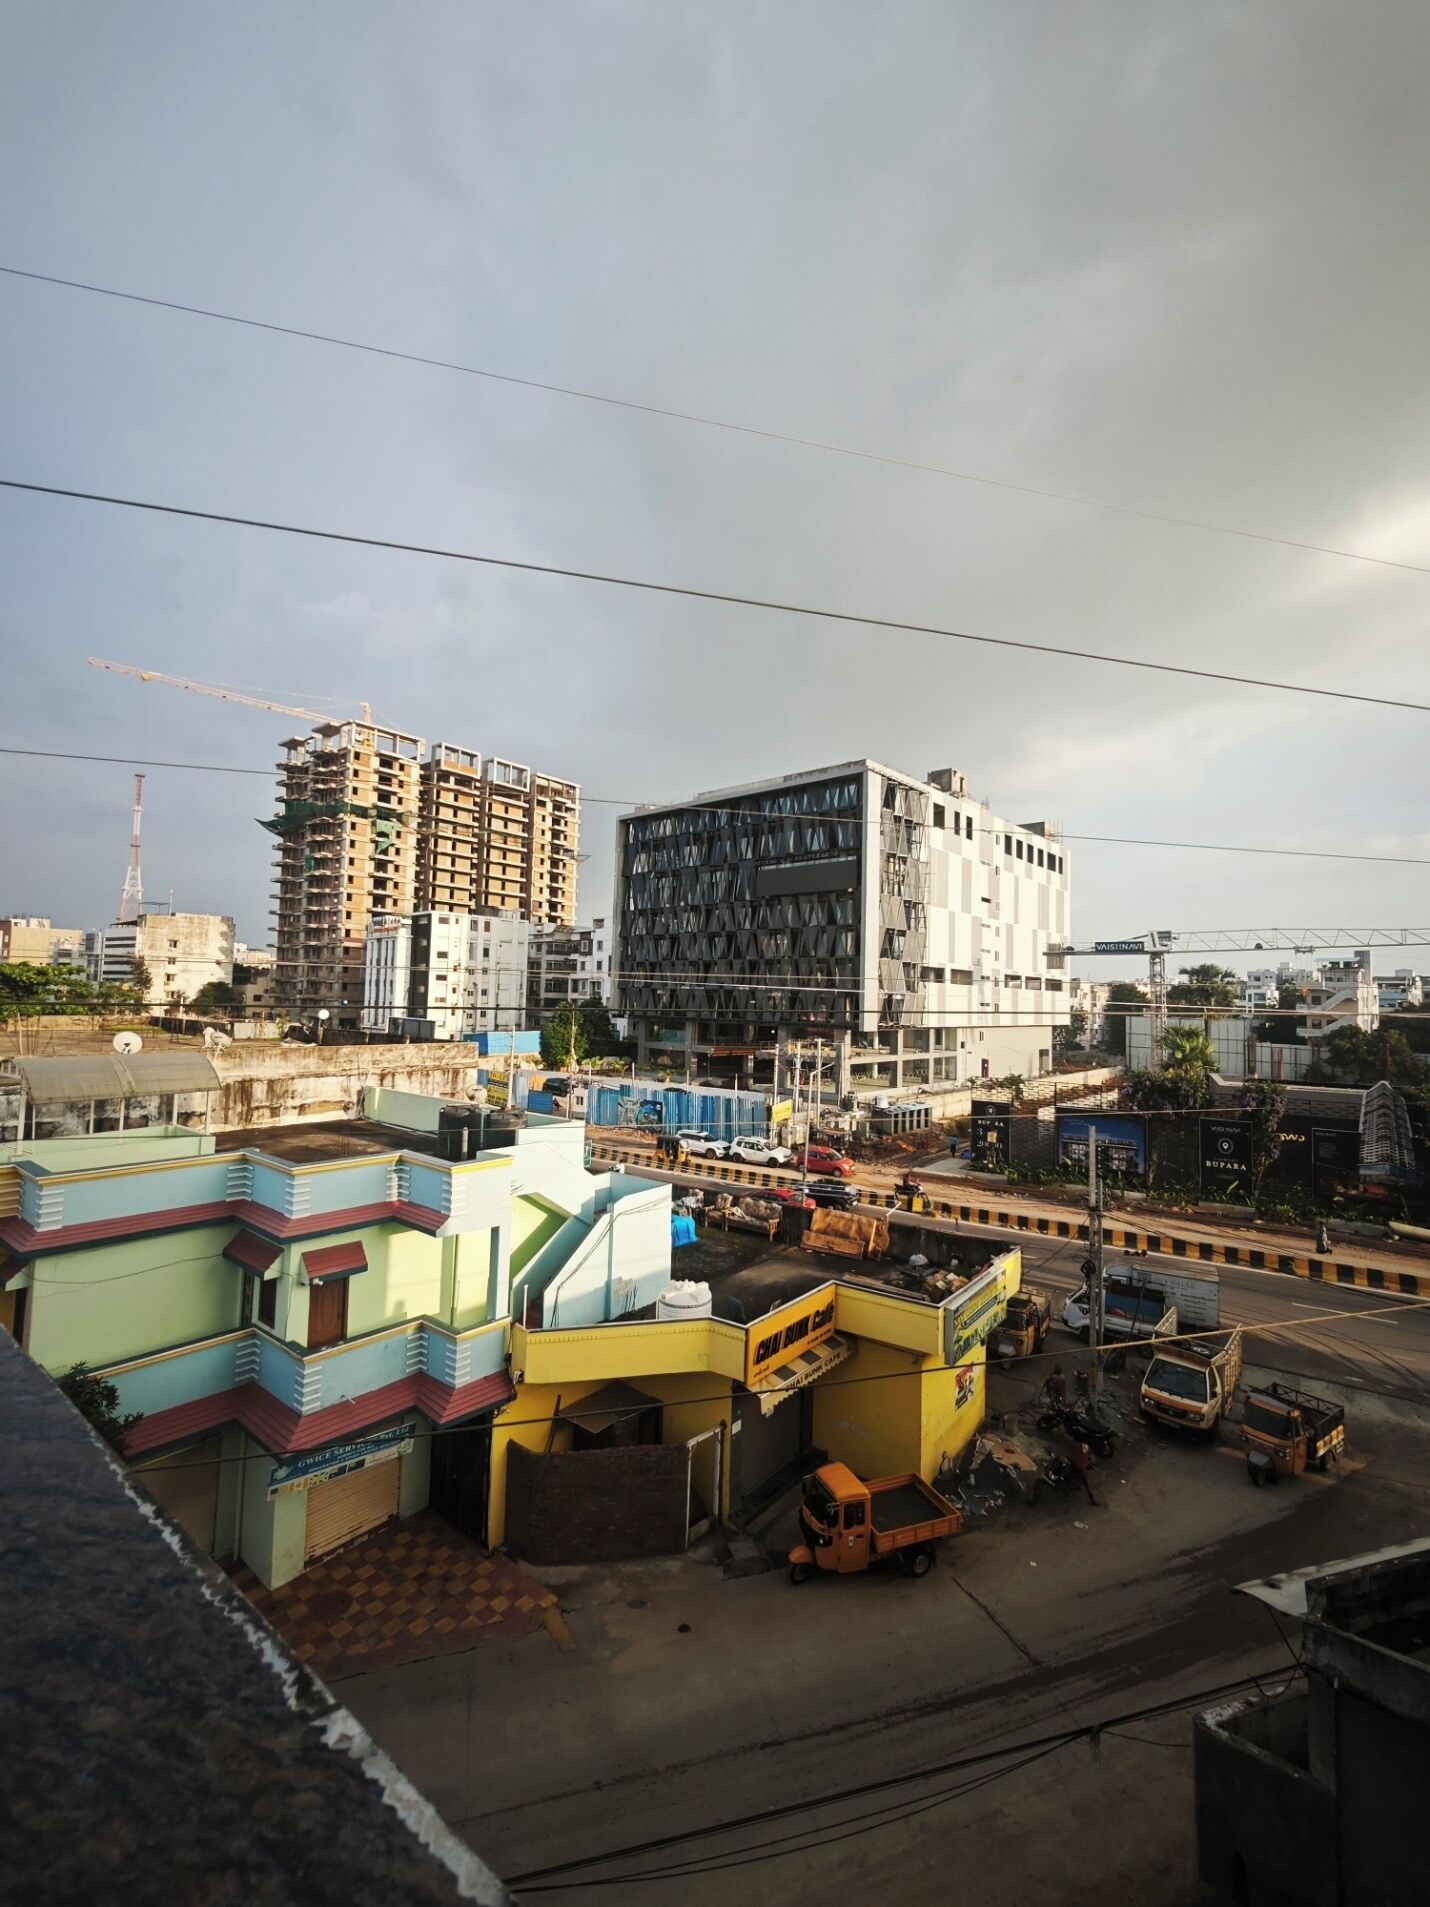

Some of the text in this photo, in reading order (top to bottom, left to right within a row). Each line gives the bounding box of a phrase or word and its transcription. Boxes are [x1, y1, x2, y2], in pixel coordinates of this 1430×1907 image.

[977, 1119, 1004, 1128] BUPRA
[1205, 1160, 1247, 1171] BUPARA
[754, 1330, 783, 1366] CHAI
[783, 1314, 811, 1349] BUNK
[804, 1363, 823, 1381] BUNK
[824, 1352, 841, 1367] CAFE
[298, 1452, 332, 1467] GWICE
